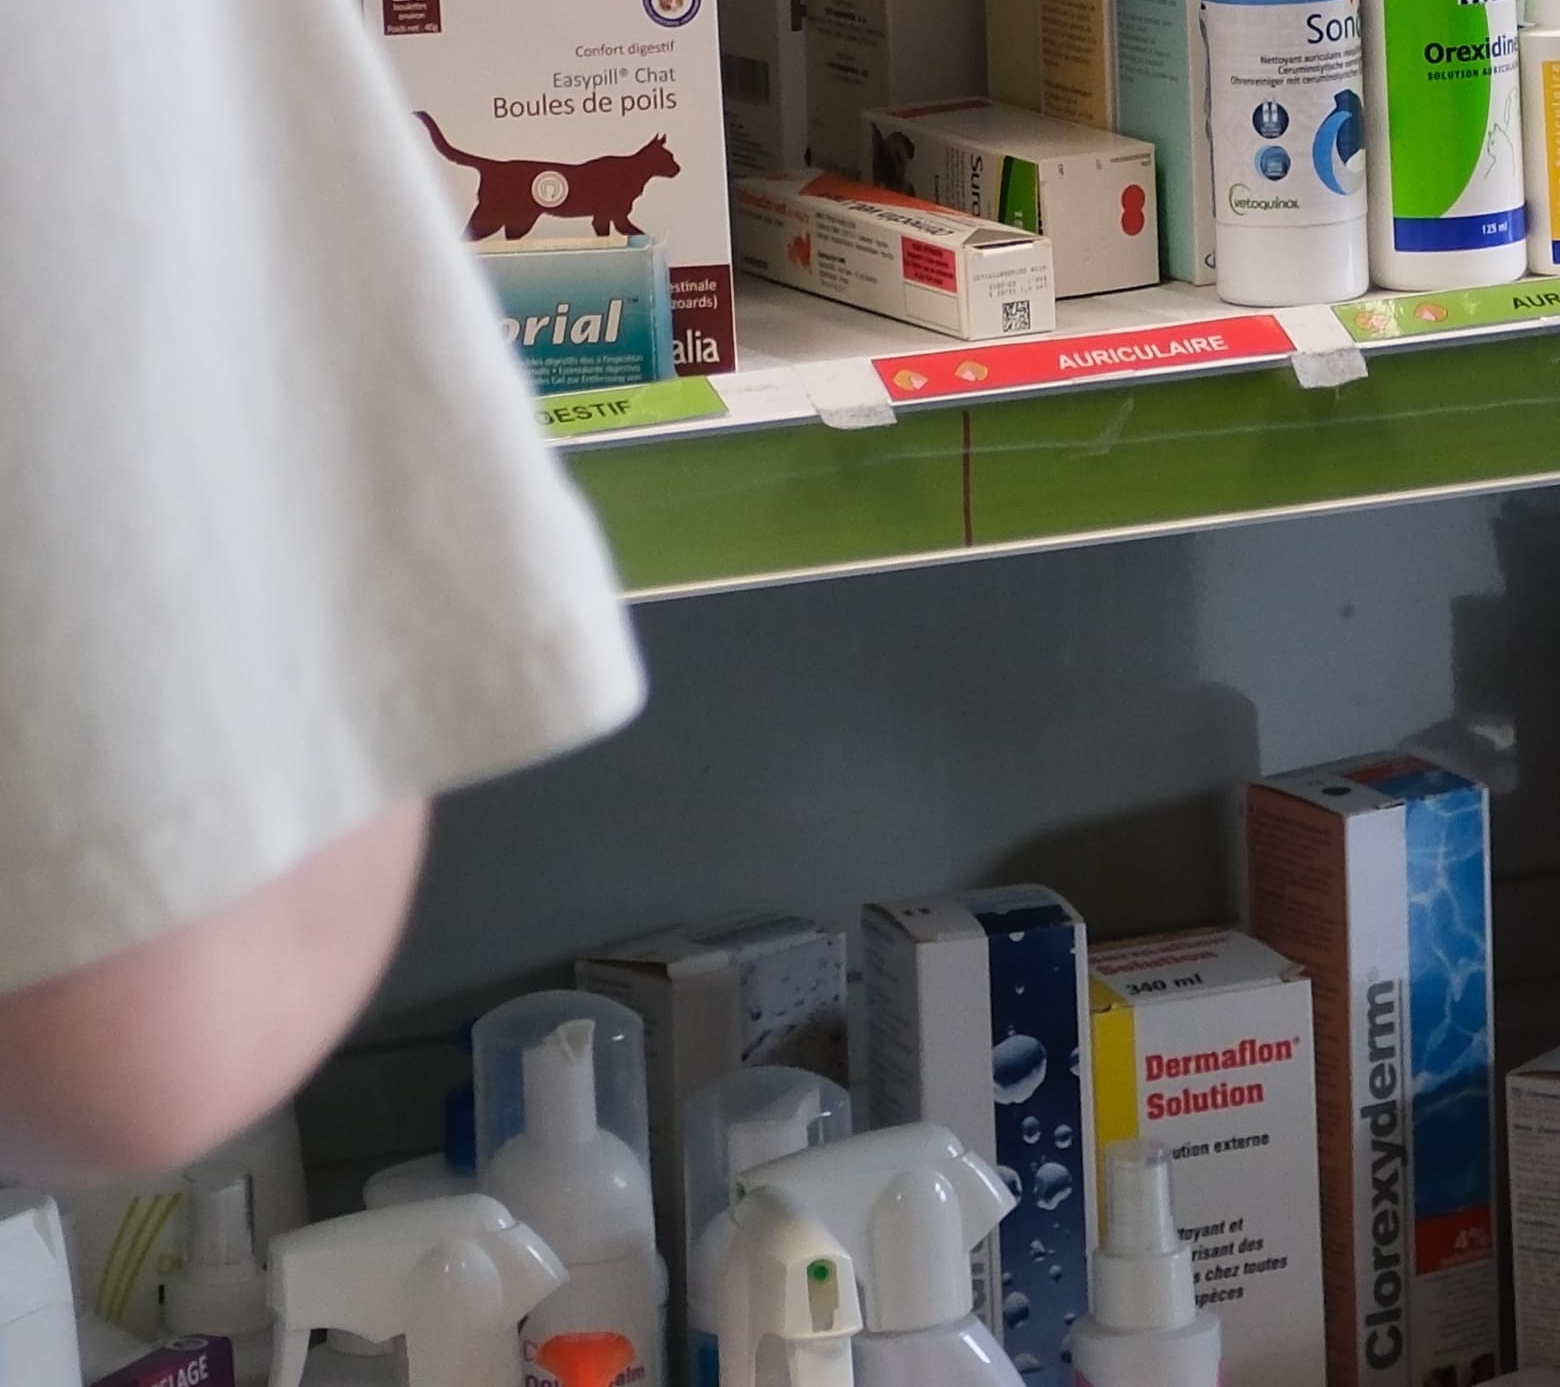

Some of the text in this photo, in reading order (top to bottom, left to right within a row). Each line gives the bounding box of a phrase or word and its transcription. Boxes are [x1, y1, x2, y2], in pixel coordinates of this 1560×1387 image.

[574, 39, 676, 59] Confort digestif
[1259, 54, 1302, 67] Nettoyant
[552, 66, 677, 91] Easypill Chat
[1229, 74, 1284, 88] Ohrenreiniger
[1427, 68, 1479, 81] SOLUTION
[492, 87, 678, 119] Boules de poils
[1481, 223, 1498, 236] 125
[1057, 333, 1230, 371] AURICULAIRE
[1126, 973, 1204, 997] 340 ml
[1144, 1037, 1295, 1084] Dermaflon
[1146, 1080, 1264, 1120] Solution
[1213, 1132, 1270, 1154] externe
[1360, 978, 1404, 1372] Clorexyderm
[1227, 1217, 1244, 1234] et
[1237, 1237, 1265, 1253] des
[1204, 1255, 1289, 1282] chez toutes
